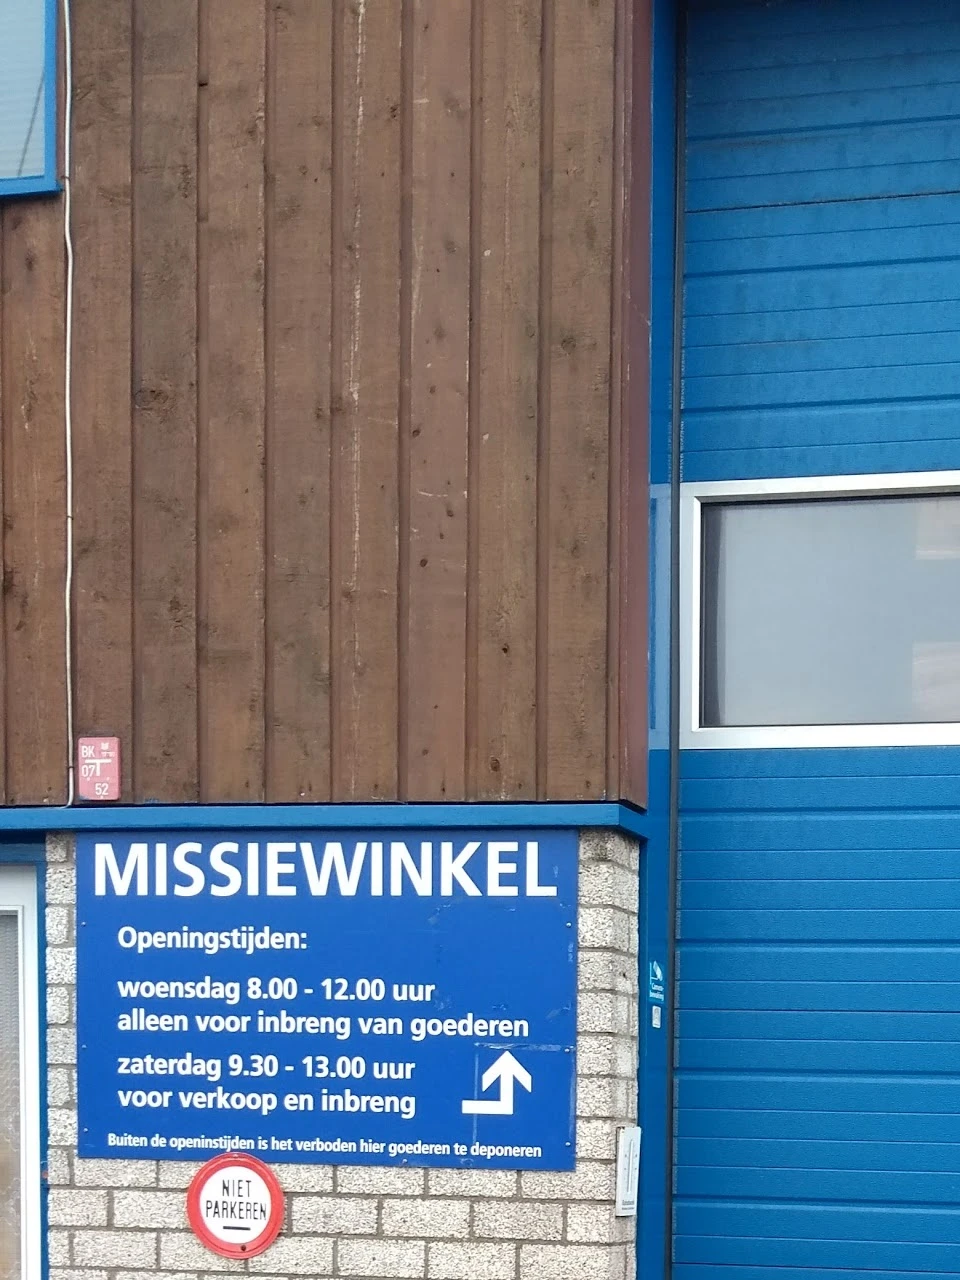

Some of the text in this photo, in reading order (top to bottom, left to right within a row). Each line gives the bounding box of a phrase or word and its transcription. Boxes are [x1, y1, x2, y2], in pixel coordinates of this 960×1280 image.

[95, 782, 109, 796] 52
[94, 841, 558, 897] MISSIEWINKEL
[117, 925, 307, 955] Openingstijden:
[117, 975, 241, 1005] woensdag
[246, 977, 298, 1000] 8.00
[320, 978, 386, 1001] 12.00
[392, 984, 436, 1002] uur
[117, 1007, 529, 1042] alleen voor inbreng van goederen
[117, 1052, 222, 1082] zaterdag
[228, 1054, 279, 1077] 9.30
[301, 1055, 366, 1079] 13.00
[373, 1062, 416, 1080] uur
[117, 1085, 416, 1120] voor verkoop en inbreng
[107, 1132, 542, 1160] Buiten de openinstijden is het verboden hier goederen te deponeren
[222, 1179, 252, 1198] NIET
[205, 1199, 266, 1220] PARKEREN
